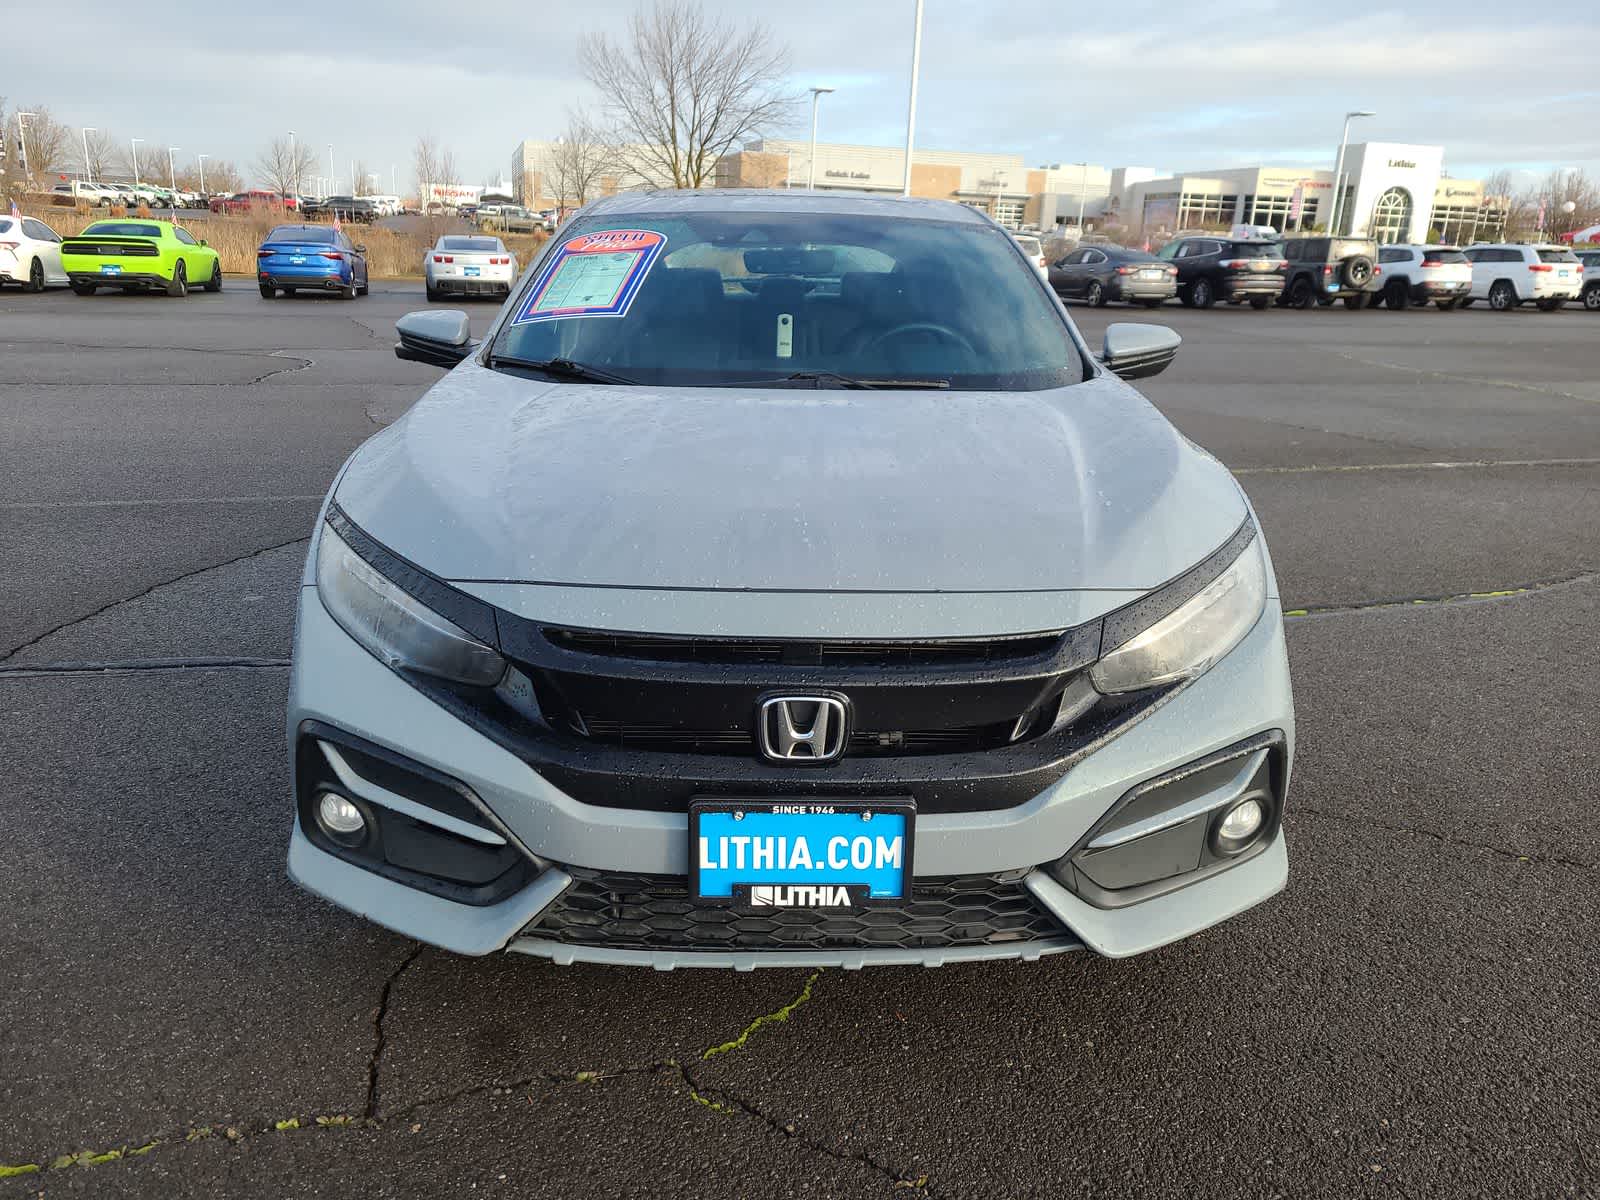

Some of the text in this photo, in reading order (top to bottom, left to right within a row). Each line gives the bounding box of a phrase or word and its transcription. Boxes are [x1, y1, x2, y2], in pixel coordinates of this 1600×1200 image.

[433, 188, 475, 197] NISSAN
[772, 805, 835, 815] SINCE 1946
[699, 836, 903, 870] LITHIA.COM
[774, 886, 851, 906] LITHIA
